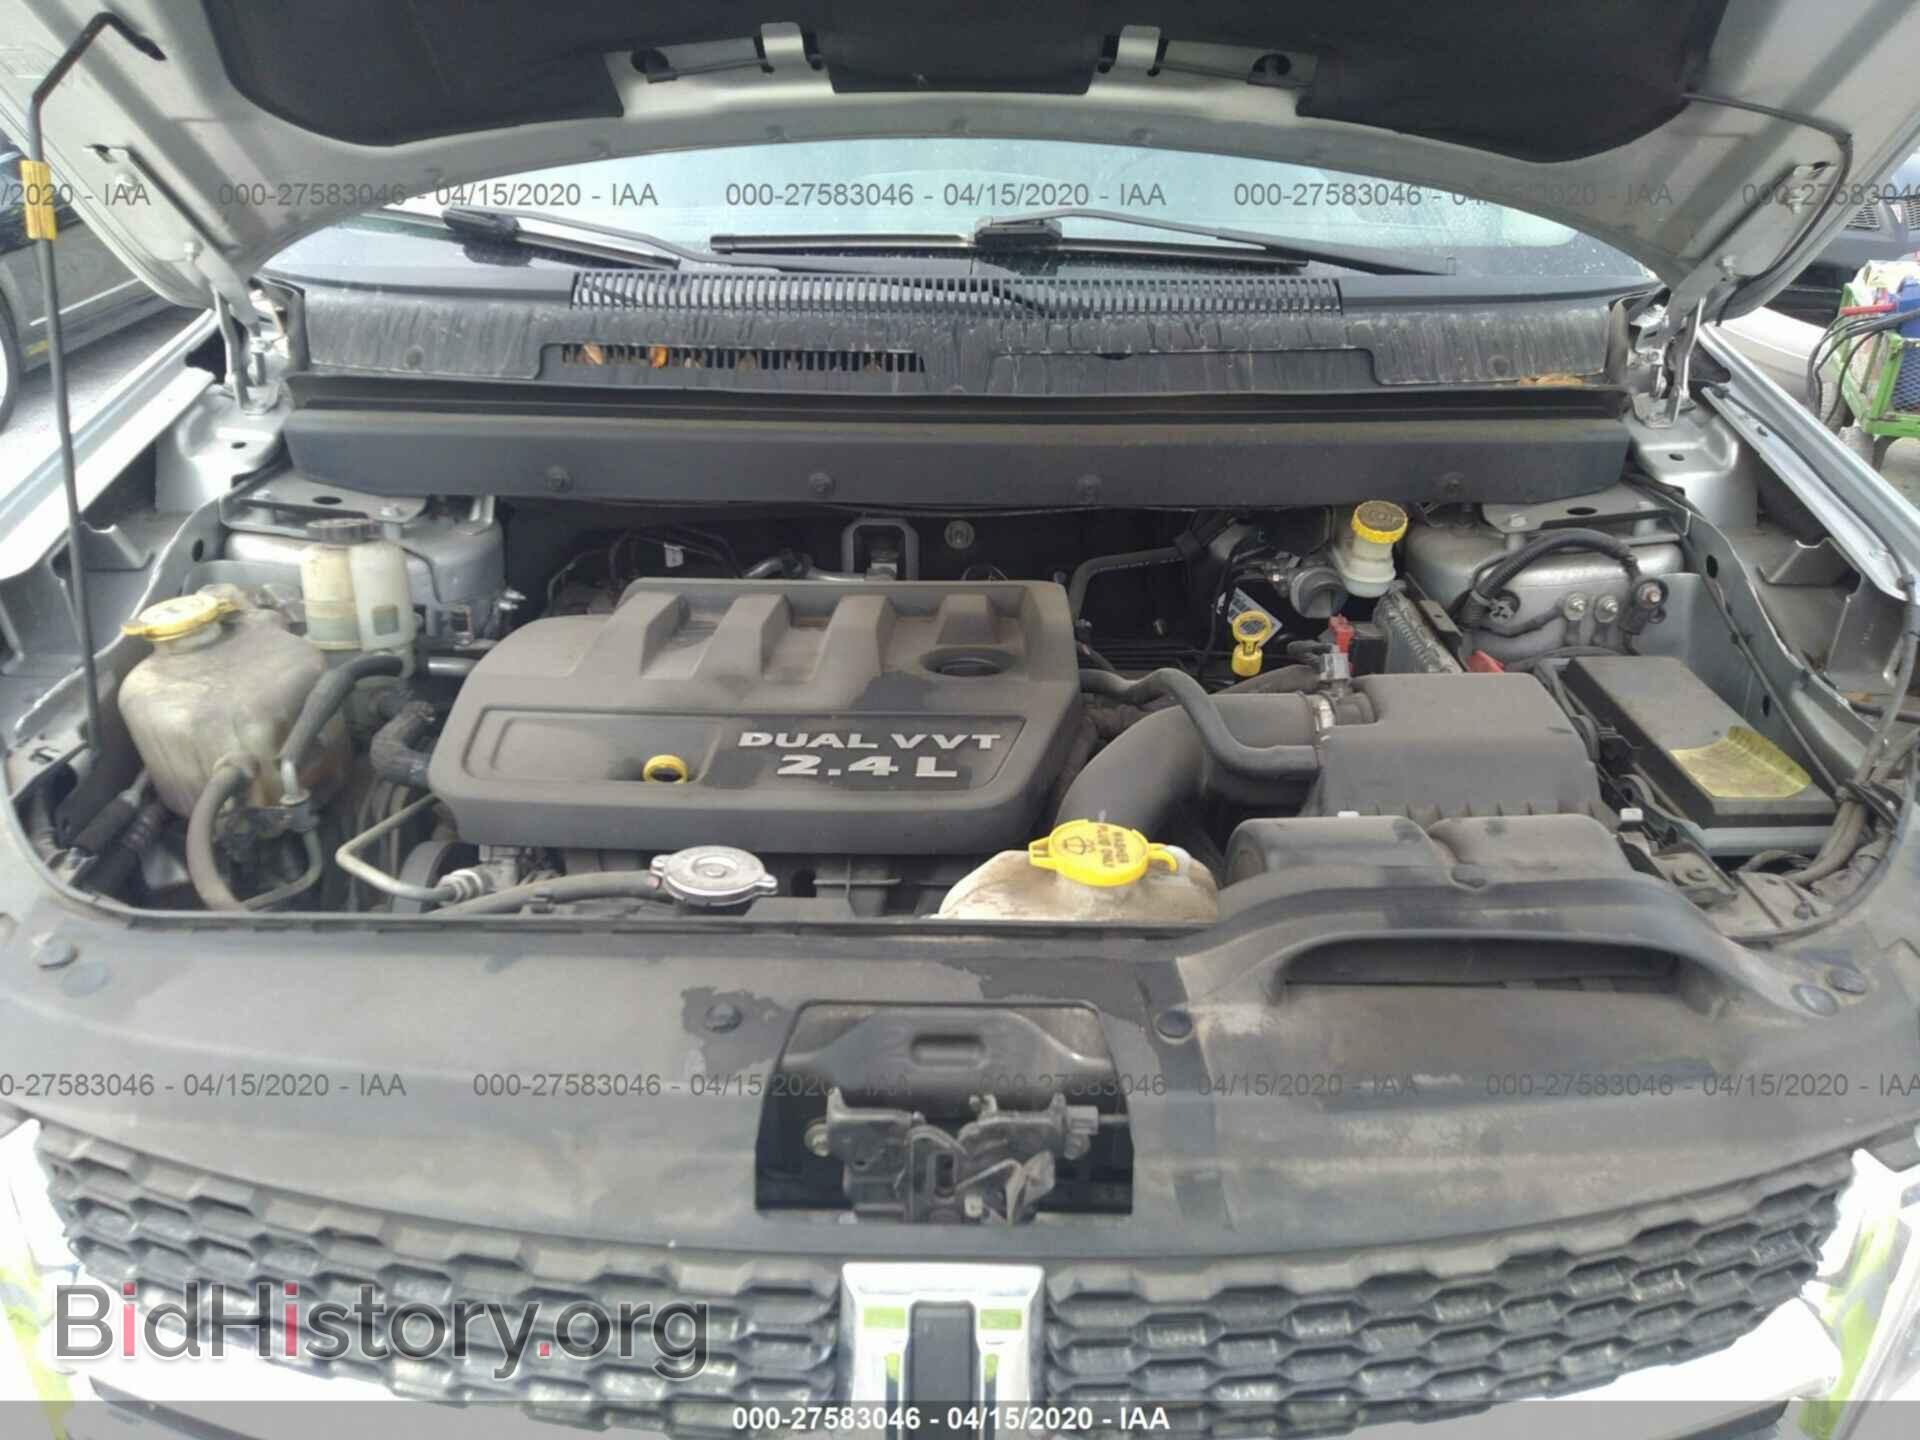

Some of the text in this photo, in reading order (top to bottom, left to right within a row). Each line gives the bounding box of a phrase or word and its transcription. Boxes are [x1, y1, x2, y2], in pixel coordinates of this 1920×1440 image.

[737, 731, 1002, 750] DUAL VVT
[776, 754, 958, 778] 2.4 L
